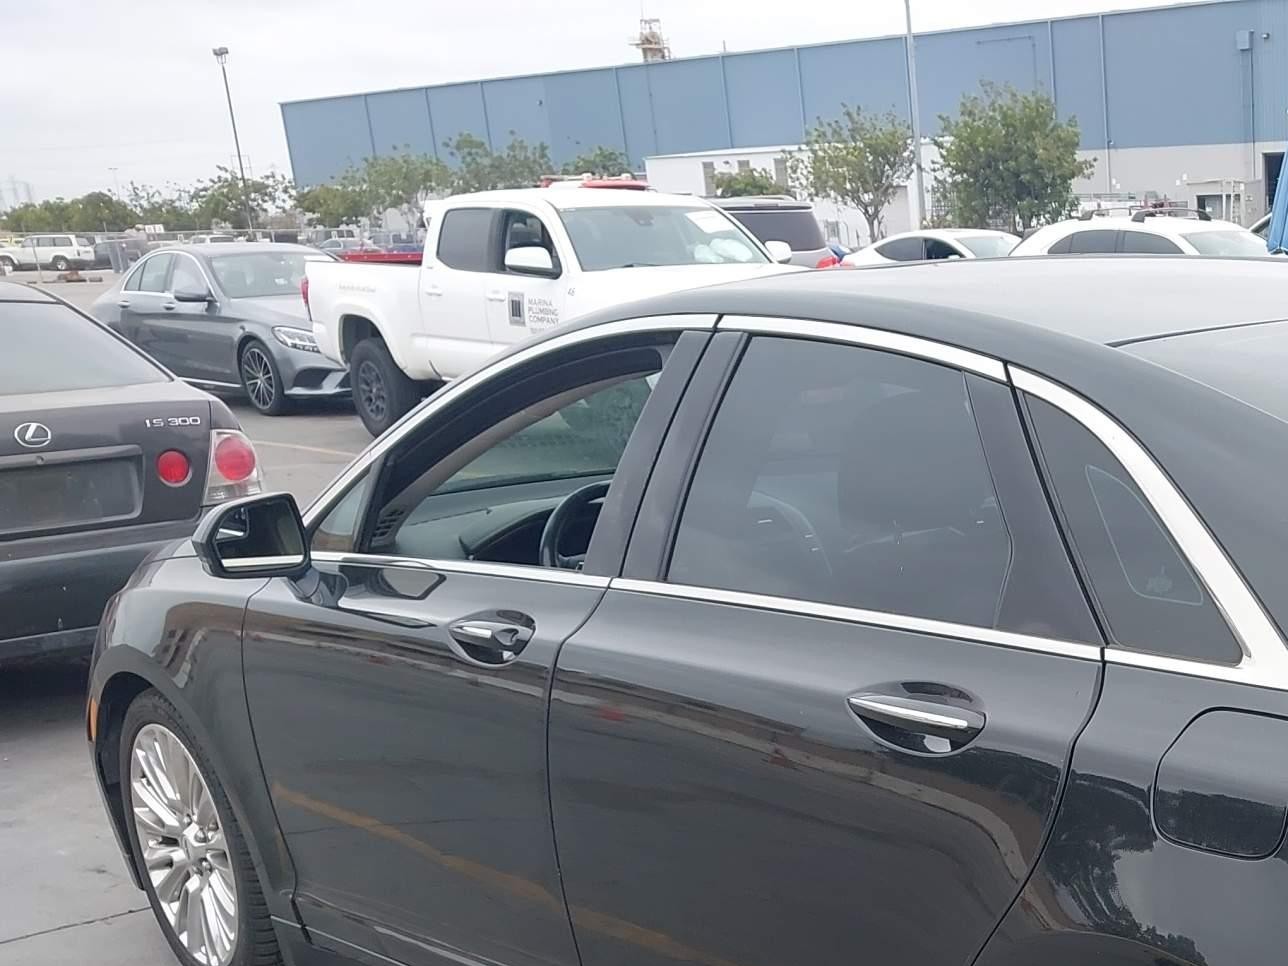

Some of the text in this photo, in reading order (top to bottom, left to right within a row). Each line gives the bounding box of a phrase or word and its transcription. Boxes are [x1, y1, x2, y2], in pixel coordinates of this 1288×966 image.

[528, 298, 553, 307] MARINA
[528, 306, 559, 317] PLUMBING
[529, 315, 559, 325] COMPANY
[145, 416, 201, 428] IS 300
